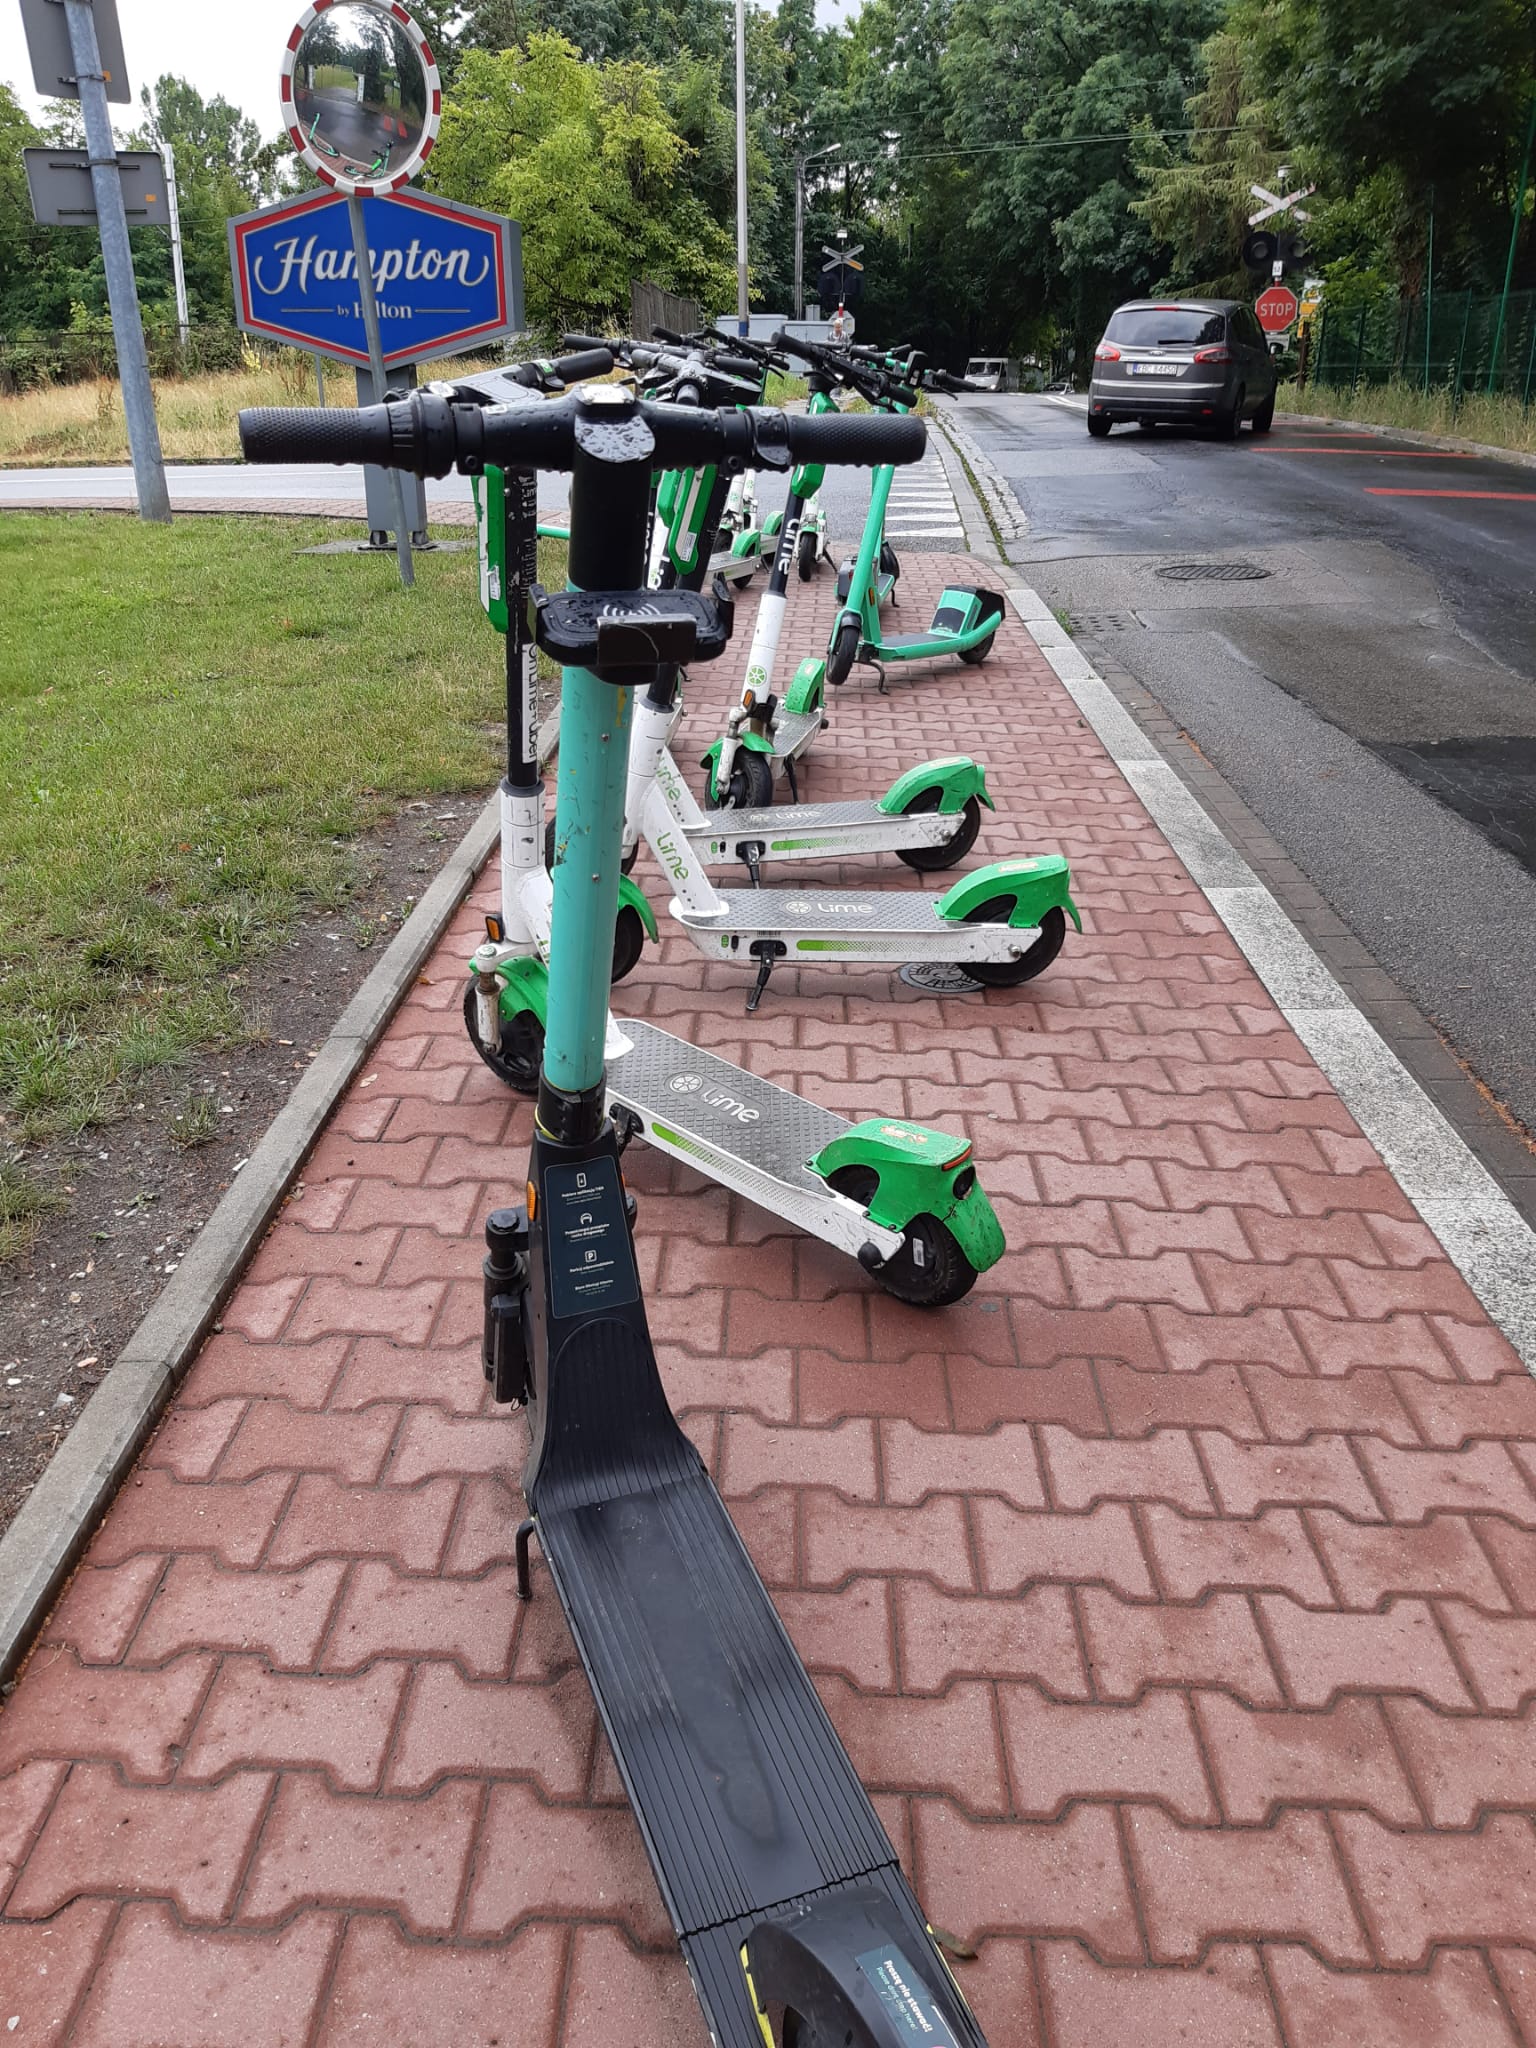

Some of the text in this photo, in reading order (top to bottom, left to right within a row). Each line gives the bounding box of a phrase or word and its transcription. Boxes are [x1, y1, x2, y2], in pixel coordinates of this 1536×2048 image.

[337, 300, 412, 319] by Hlton
[1260, 302, 1293, 317] STOP
[775, 809, 823, 820] Lime
[656, 831, 689, 881] Lime
[817, 902, 874, 914] Lime
[702, 1087, 760, 1123] Lime
[899, 1984, 911, 1998] nie
